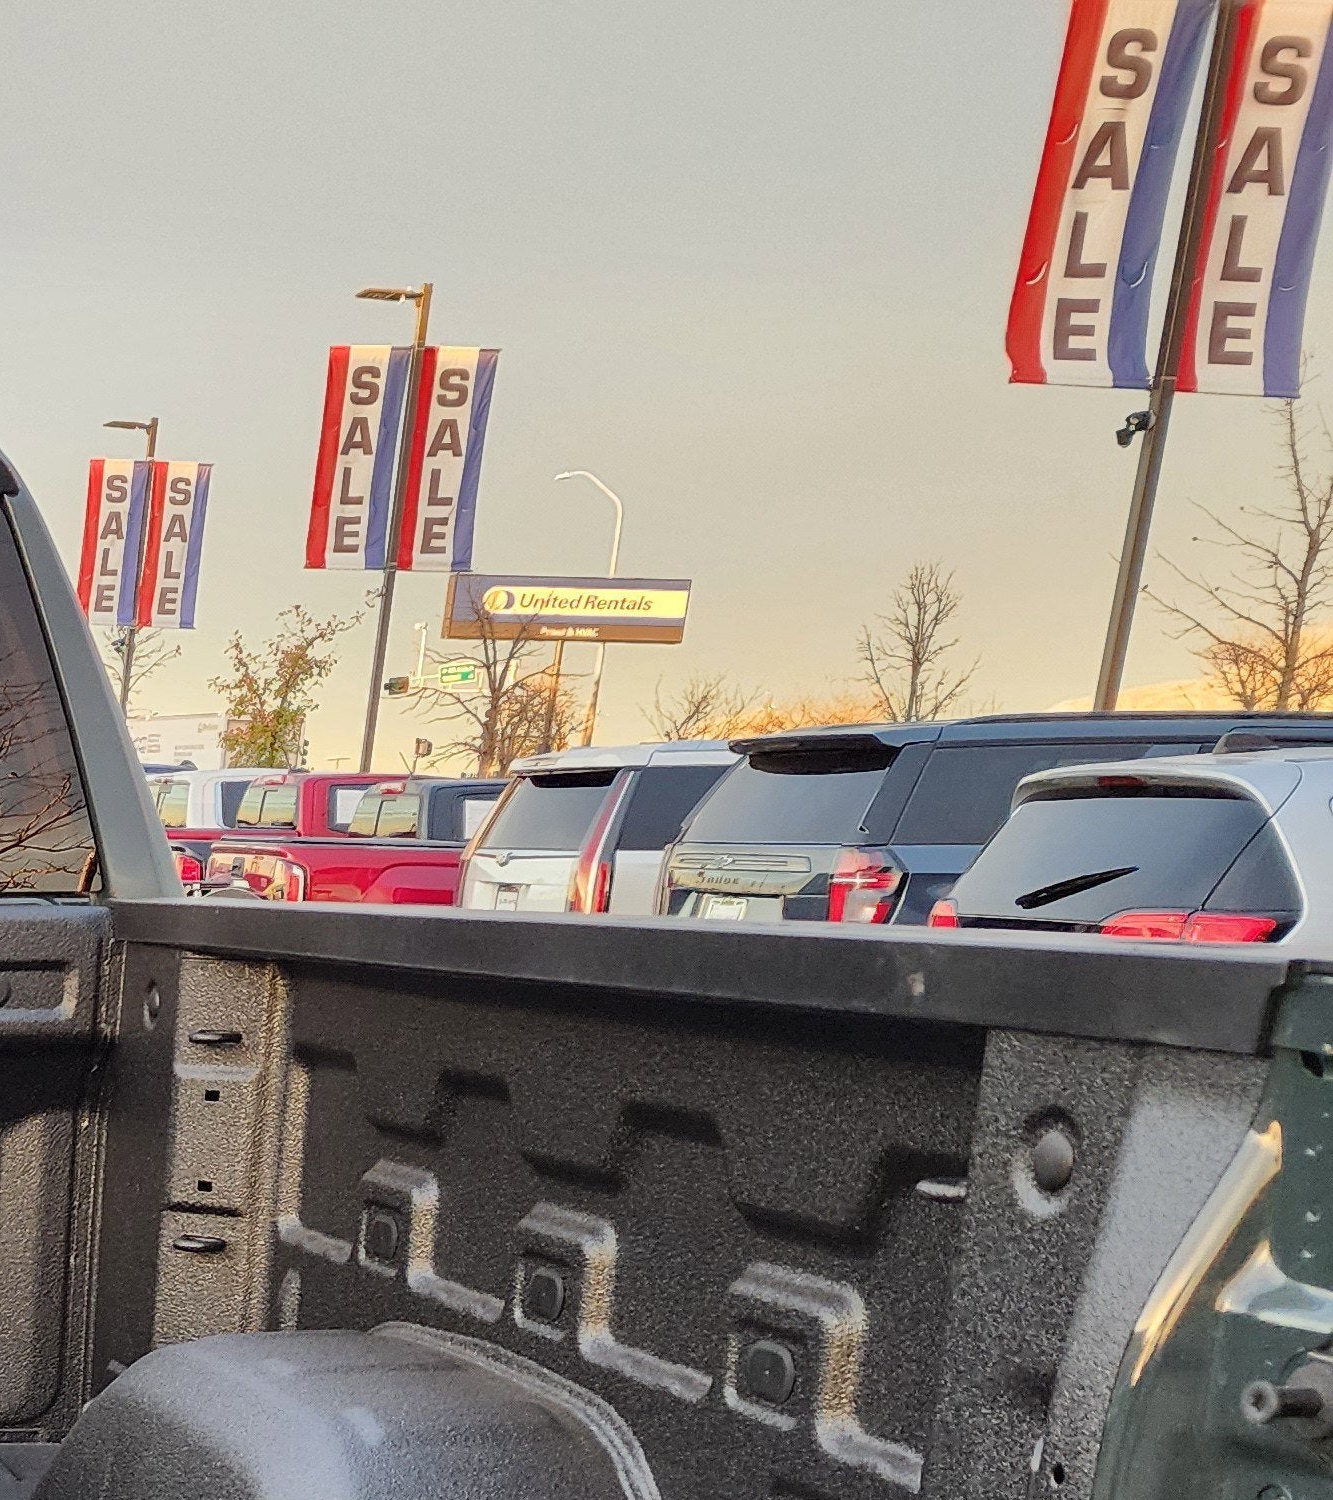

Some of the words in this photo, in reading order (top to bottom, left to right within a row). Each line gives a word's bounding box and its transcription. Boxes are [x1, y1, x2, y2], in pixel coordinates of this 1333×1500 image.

[1052, 27, 1158, 362] SALE
[1206, 35, 1313, 366] SALE
[93, 474, 129, 613] SALE
[156, 476, 192, 616] SALE
[333, 365, 381, 554] SALE
[419, 367, 470, 555] SALE
[519, 591, 583, 610] United
[583, 594, 654, 612] Rentals
